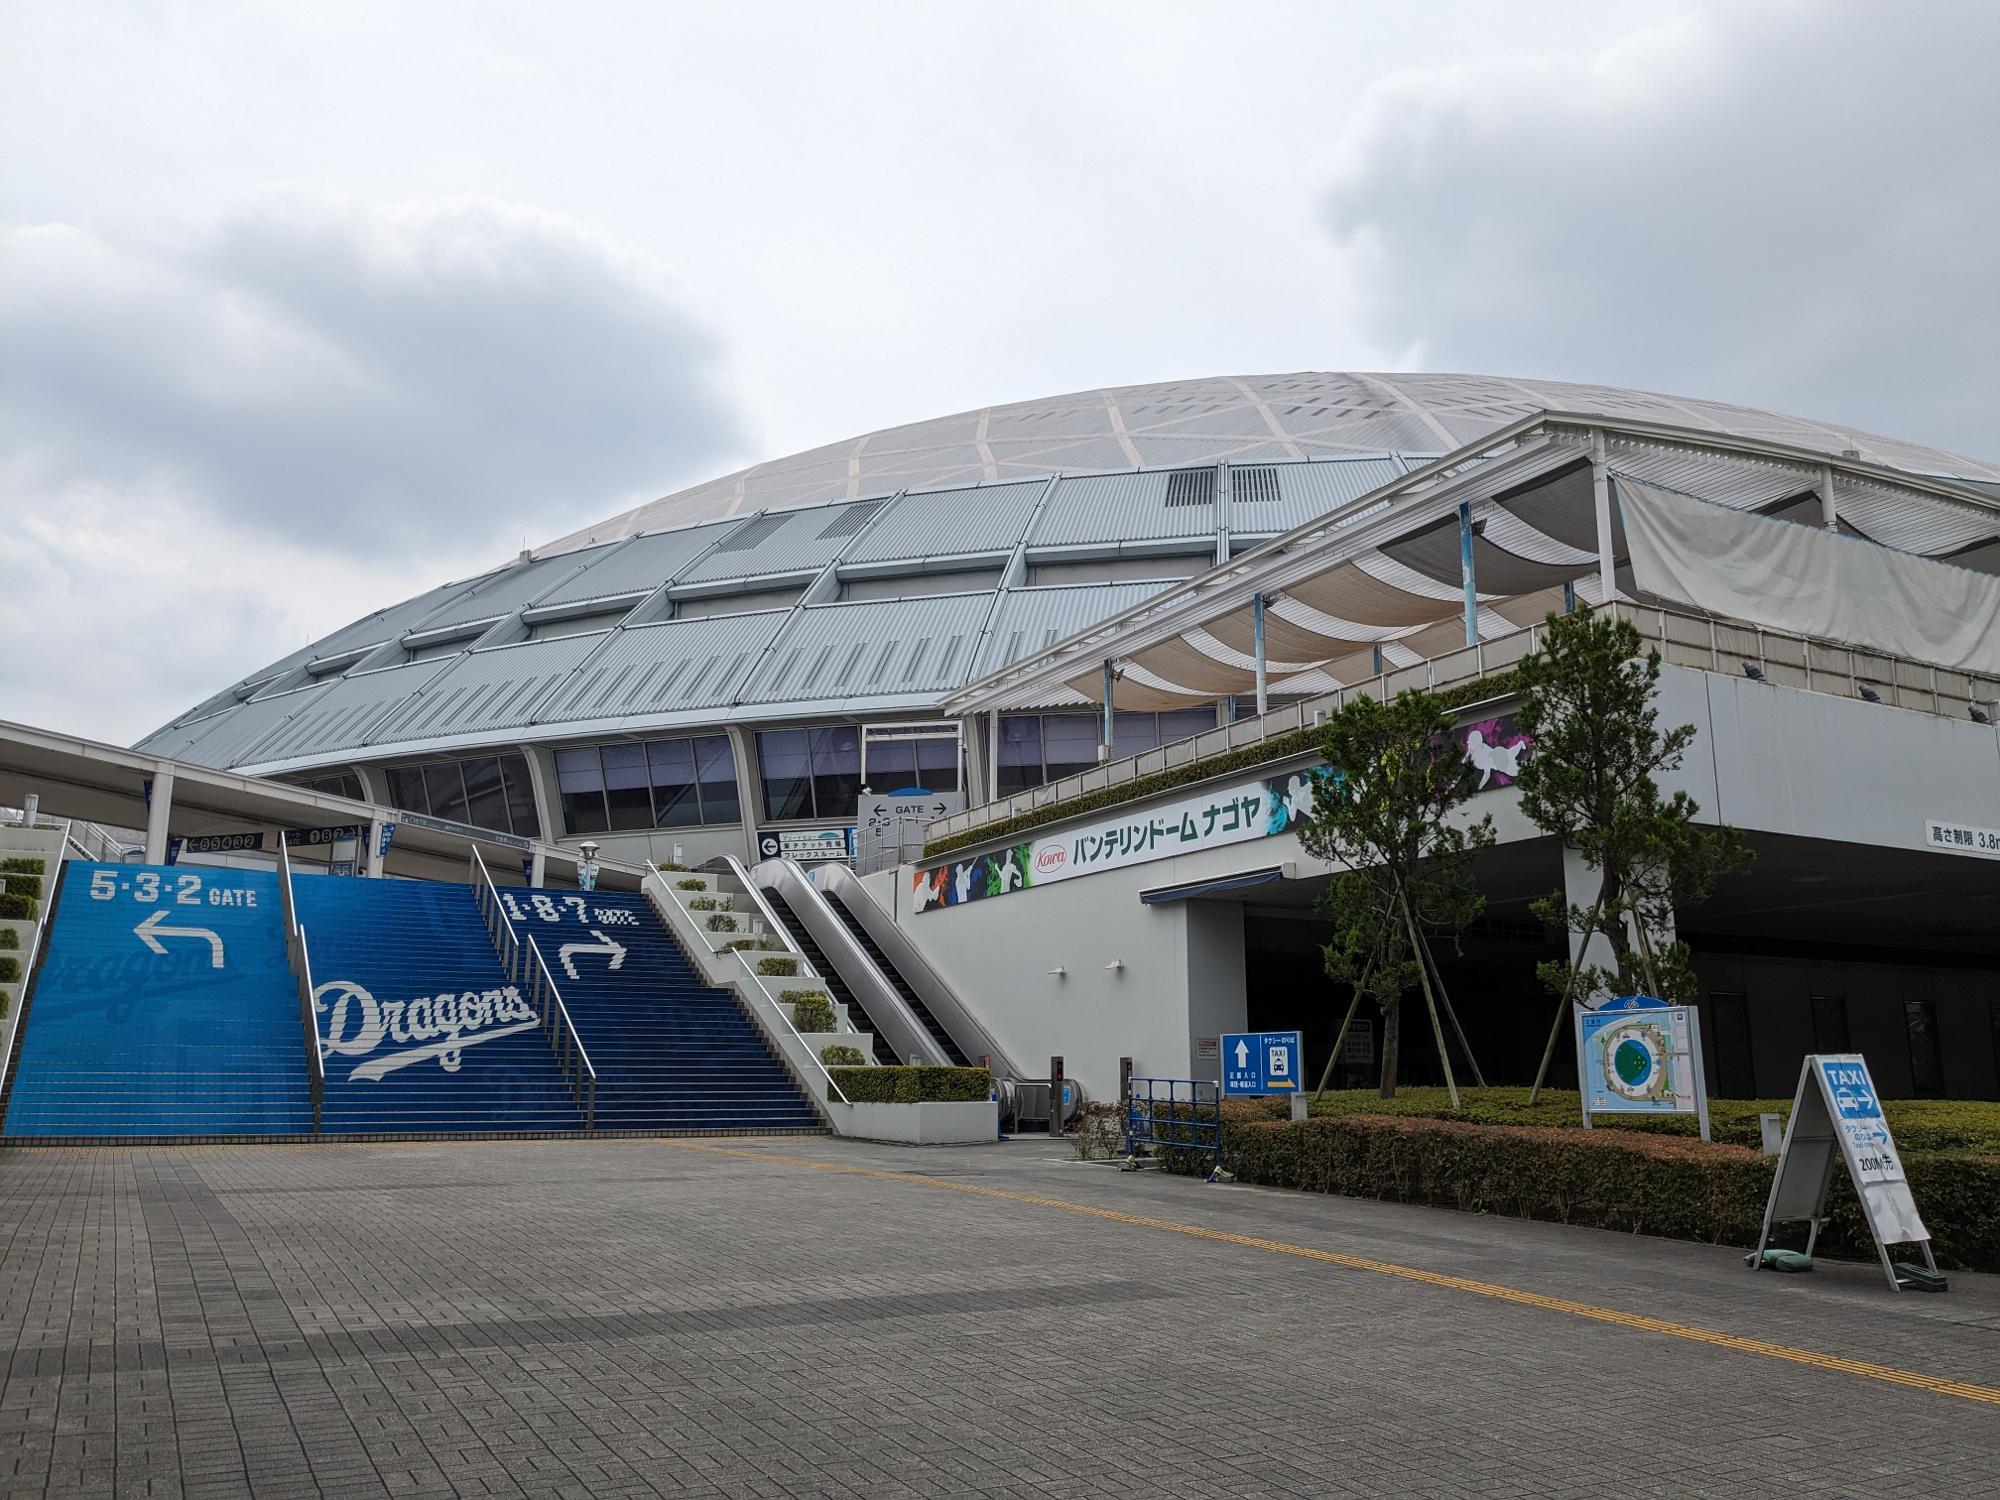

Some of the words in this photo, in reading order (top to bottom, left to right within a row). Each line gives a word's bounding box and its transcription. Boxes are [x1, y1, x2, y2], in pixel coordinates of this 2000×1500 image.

[895, 805, 925, 815] GATE
[1073, 812, 1198, 866] バンテリンドーム
[1203, 795, 1261, 838] ナゴヤ
[1932, 826, 1974, 846] 高さ制限
[784, 850, 843, 859] フレックスルーム
[1037, 849, 1065, 869] Kowa
[209, 888, 258, 907] GATE
[313, 980, 541, 1082] Dragons
[1271, 1049, 1286, 1058] TAXI
[1827, 1070, 1867, 1085] TAXI
